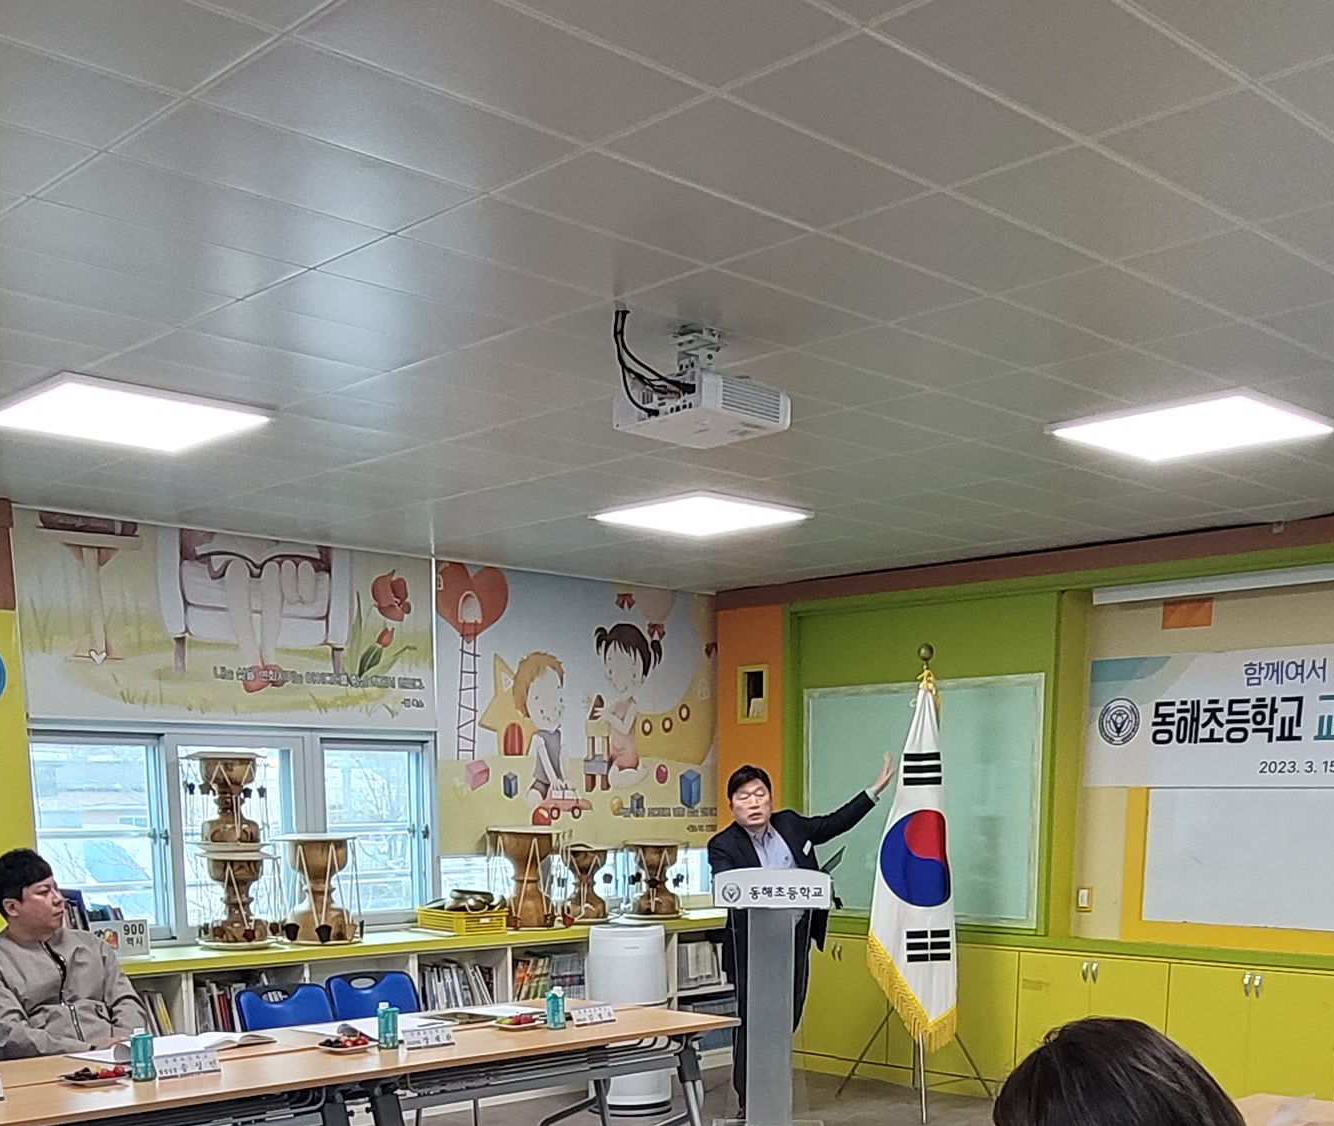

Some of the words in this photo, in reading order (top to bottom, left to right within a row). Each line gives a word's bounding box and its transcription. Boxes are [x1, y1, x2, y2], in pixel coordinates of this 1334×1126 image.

[1244, 659, 1327, 687] 함께여서
[1151, 695, 1304, 745] 동해초등학교
[1259, 760, 1300, 774] 2023.
[1304, 760, 1317, 774] 3.
[748, 886, 824, 900] 동해초등학교
